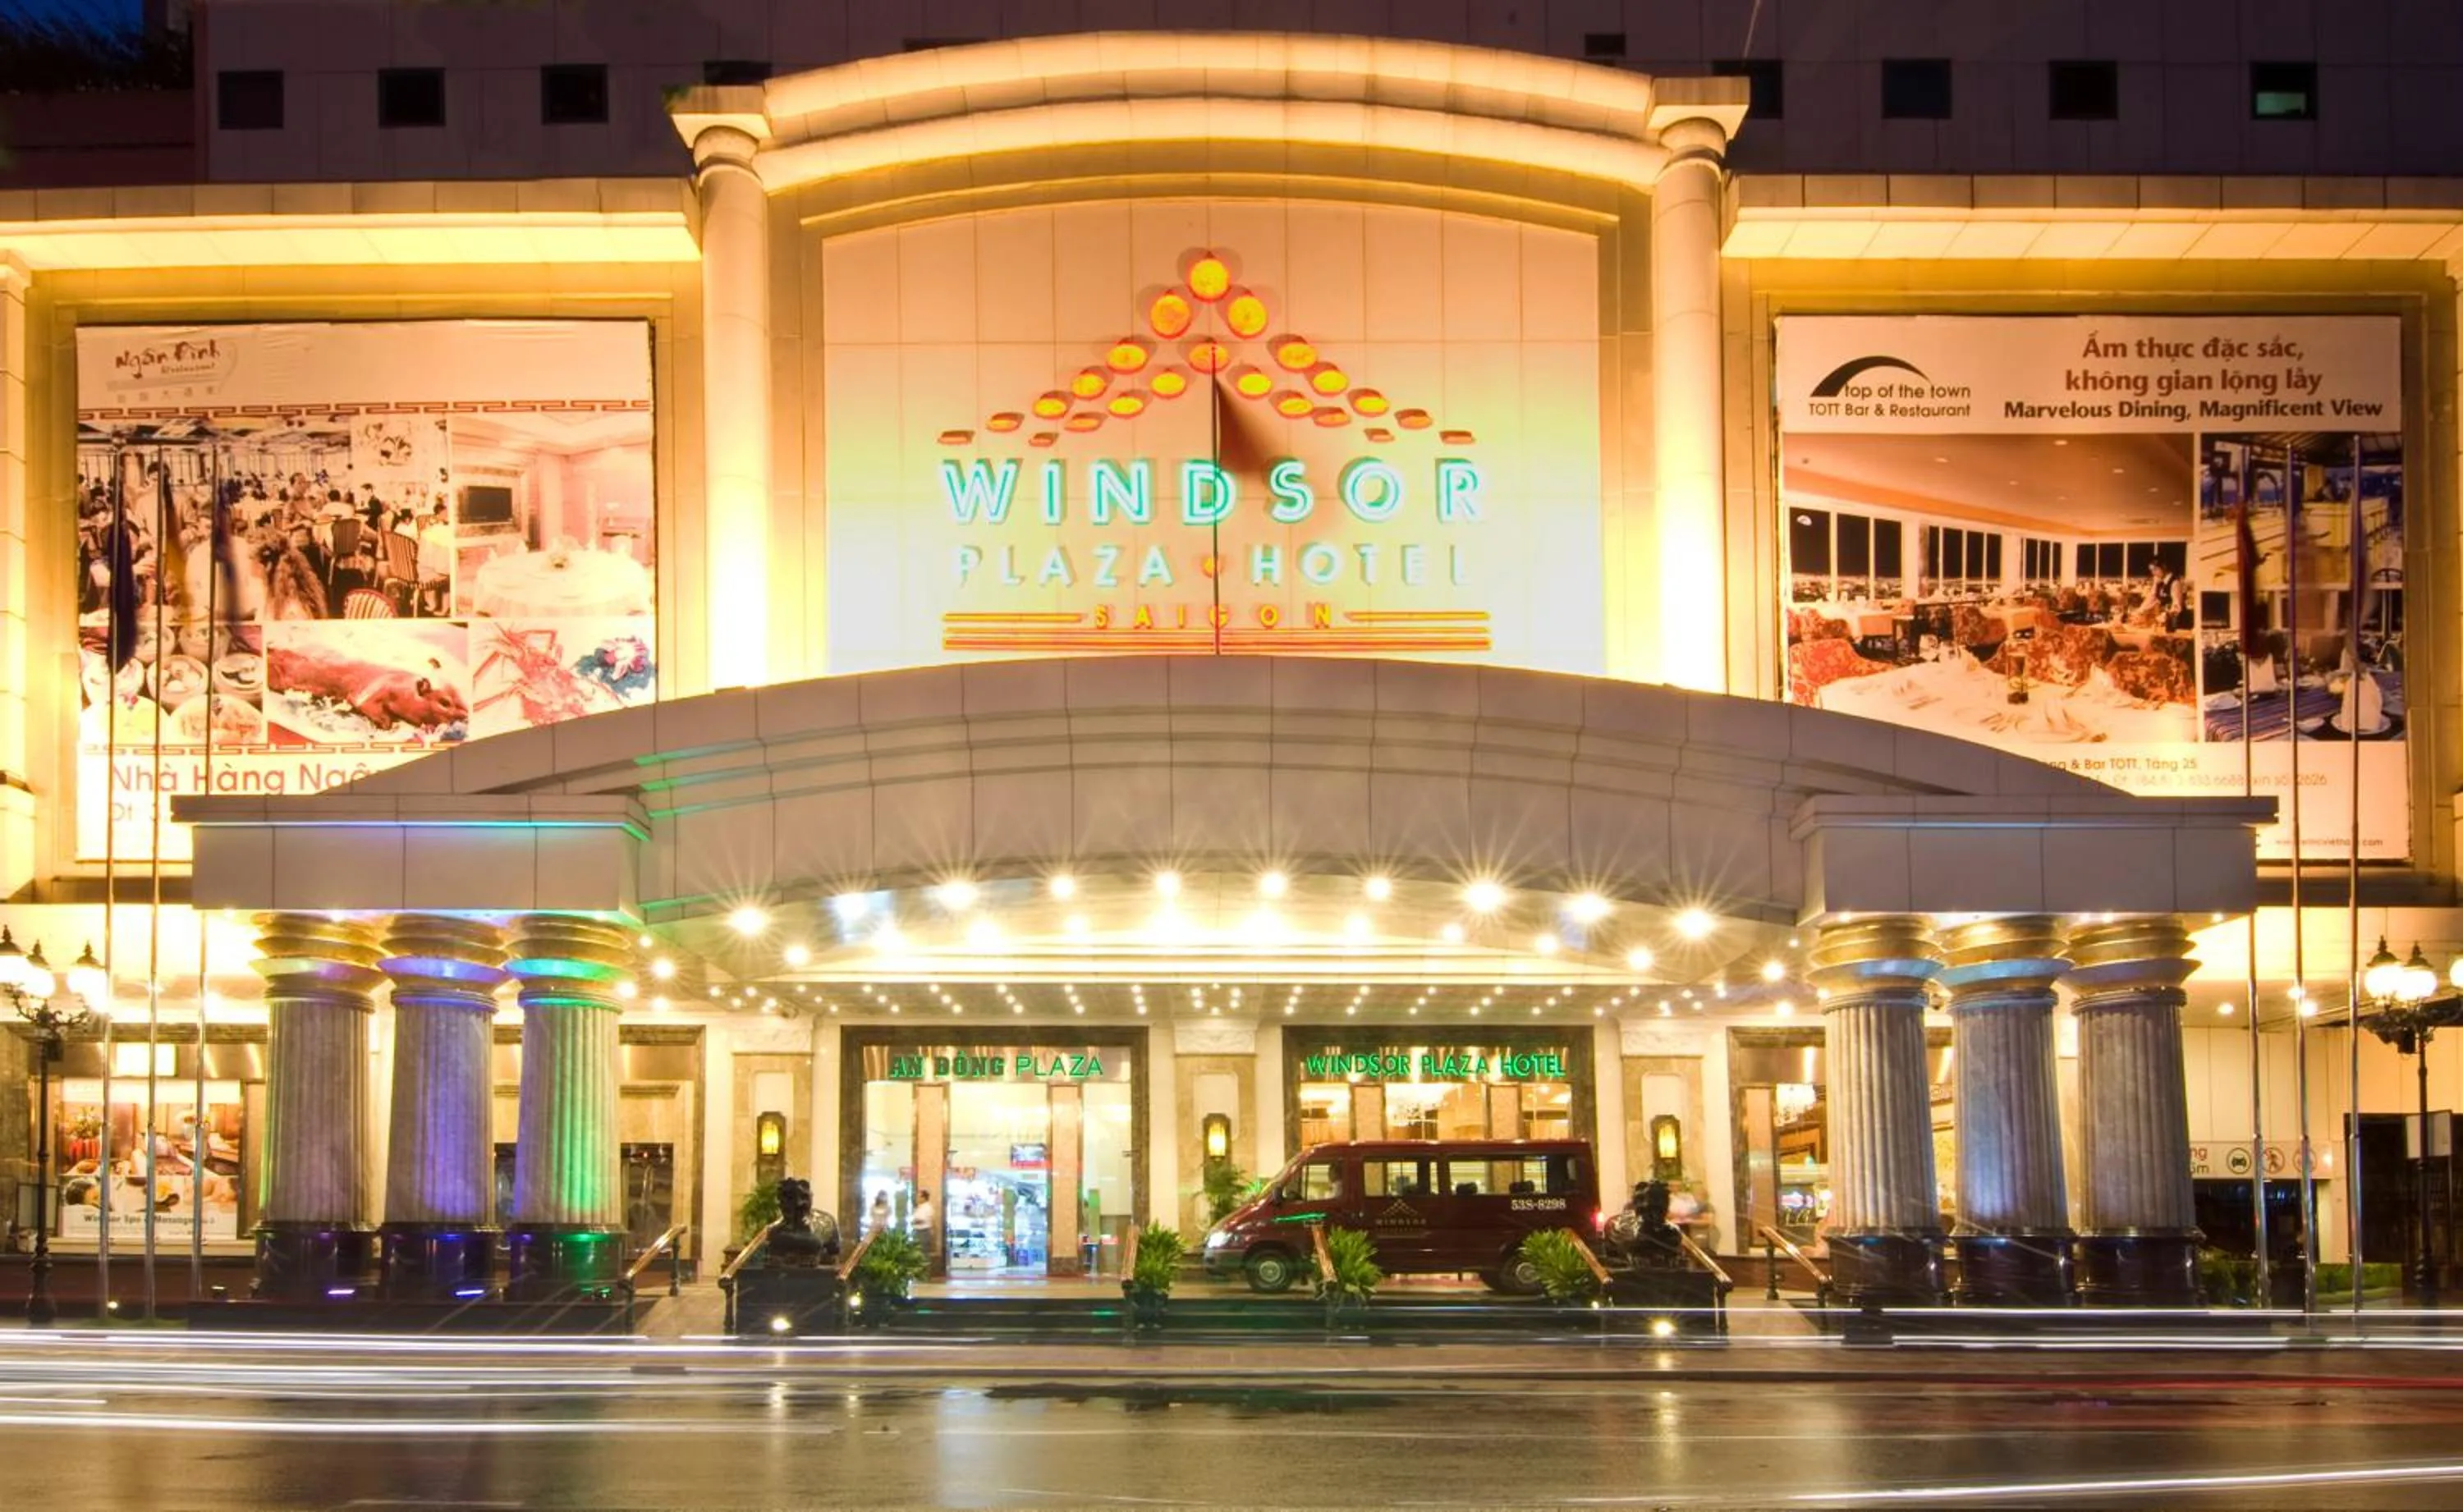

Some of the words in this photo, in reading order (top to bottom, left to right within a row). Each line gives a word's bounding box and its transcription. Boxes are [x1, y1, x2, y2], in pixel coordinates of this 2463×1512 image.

[2082, 329, 2128, 358] Ấm
[2135, 337, 2195, 362] thực
[2202, 336, 2249, 362] đặc
[2257, 333, 2304, 361] sắc,
[1845, 385, 1873, 400] top
[1878, 384, 1893, 398] of
[1898, 383, 1924, 398] the
[1930, 385, 1970, 399] town
[2066, 369, 2149, 396] không
[2157, 371, 2213, 396] gian
[2221, 369, 2277, 396] lộng
[1809, 403, 1840, 416] TOTT
[1845, 403, 1869, 416] Bar
[1874, 403, 1884, 416] &
[1890, 402, 1970, 418] Restaurant
[2003, 401, 2112, 419] Marvelous
[2118, 401, 2191, 422] Dining,
[2199, 399, 2324, 419] Magnificent
[2332, 398, 2383, 417] View
[940, 456, 1487, 525] WINDSOR
[952, 543, 1176, 588] PLAZA
[1250, 542, 1479, 588] HOTEL
[1093, 603, 1333, 630] SAIGON
[2085, 758, 2106, 770] Bar
[112, 763, 177, 791] Nhà
[192, 762, 285, 795] Hàng
[890, 1053, 924, 1078] AN
[1016, 1056, 1103, 1077] PLAZA
[1306, 1053, 1410, 1077] WINDSOR
[1421, 1054, 1489, 1076] PLAZA
[1500, 1053, 1566, 1077] HOTEL
